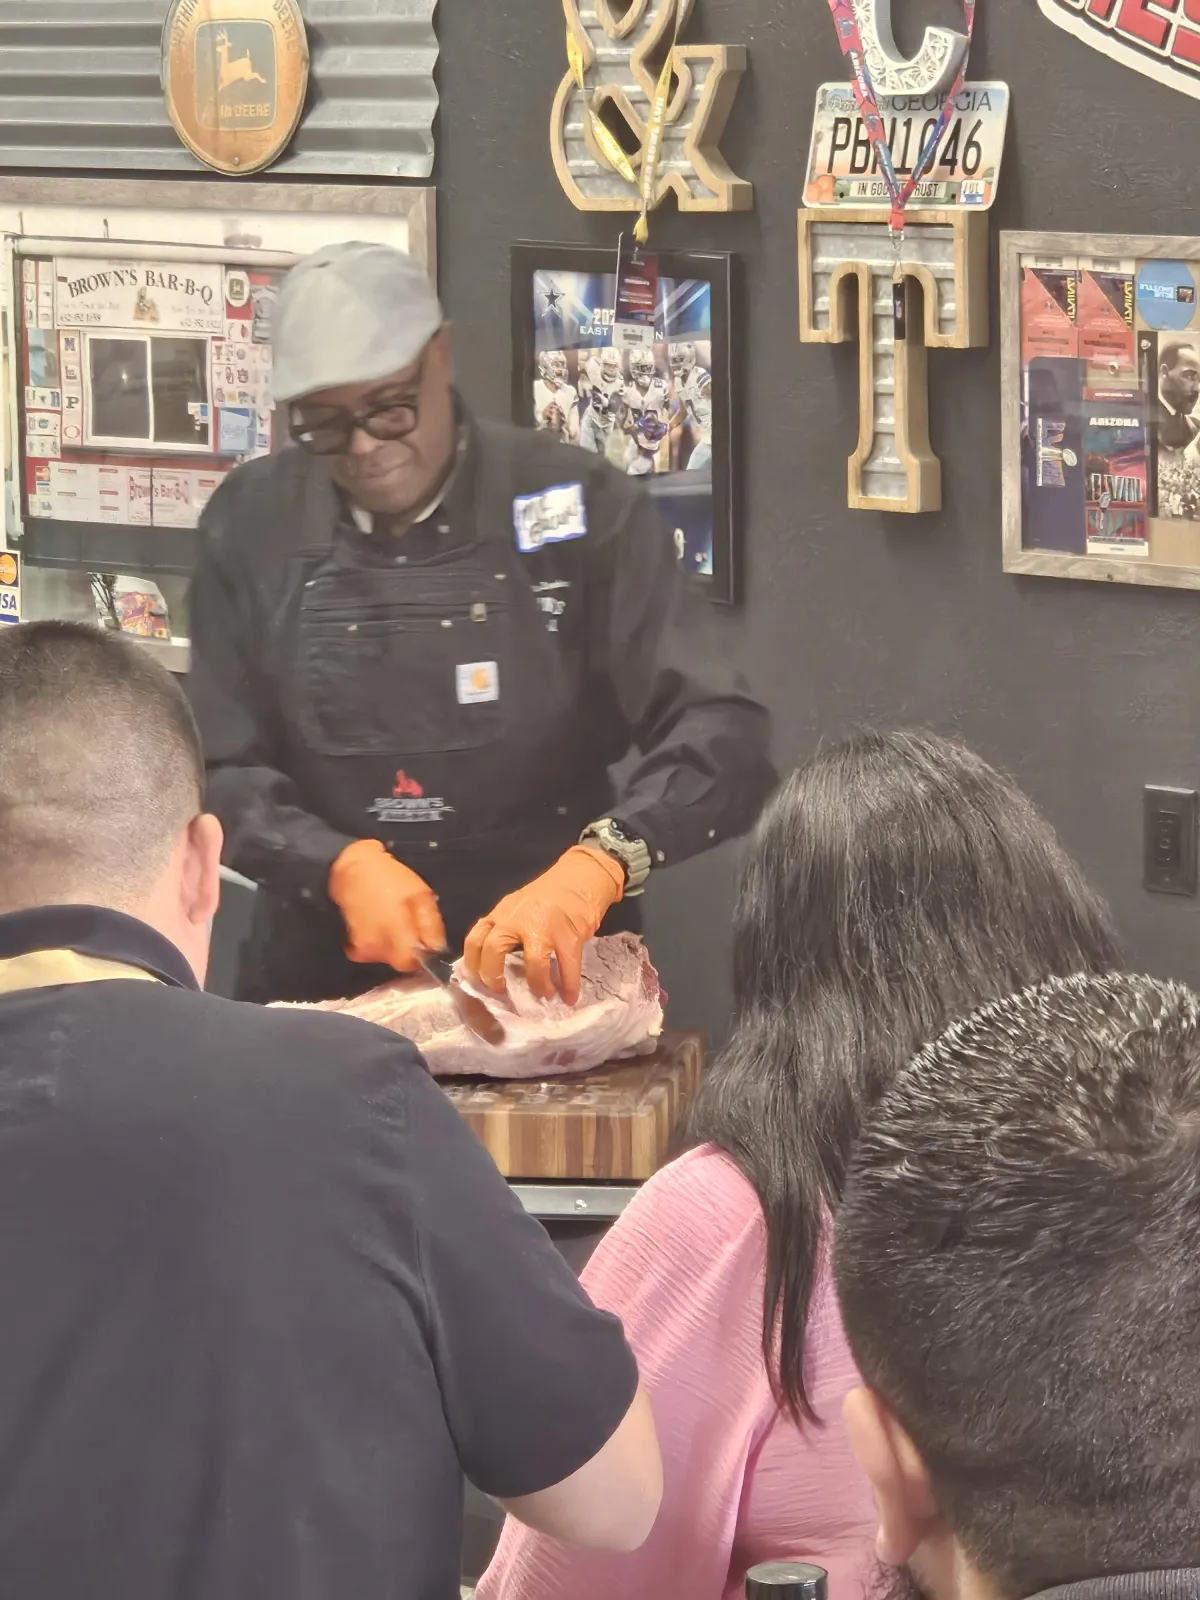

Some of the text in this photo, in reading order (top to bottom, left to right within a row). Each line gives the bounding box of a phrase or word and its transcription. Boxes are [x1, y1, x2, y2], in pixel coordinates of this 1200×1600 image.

[857, 183, 868, 195] IN
[914, 183, 939, 197] RUST
[67, 269, 214, 305] BROWN'S BAR-B-Q
[592, 308, 616, 326] 202
[580, 326, 608, 336] EAST
[1089, 417, 1139, 427] ARIZONA
[0, 593, 17, 610] SA
